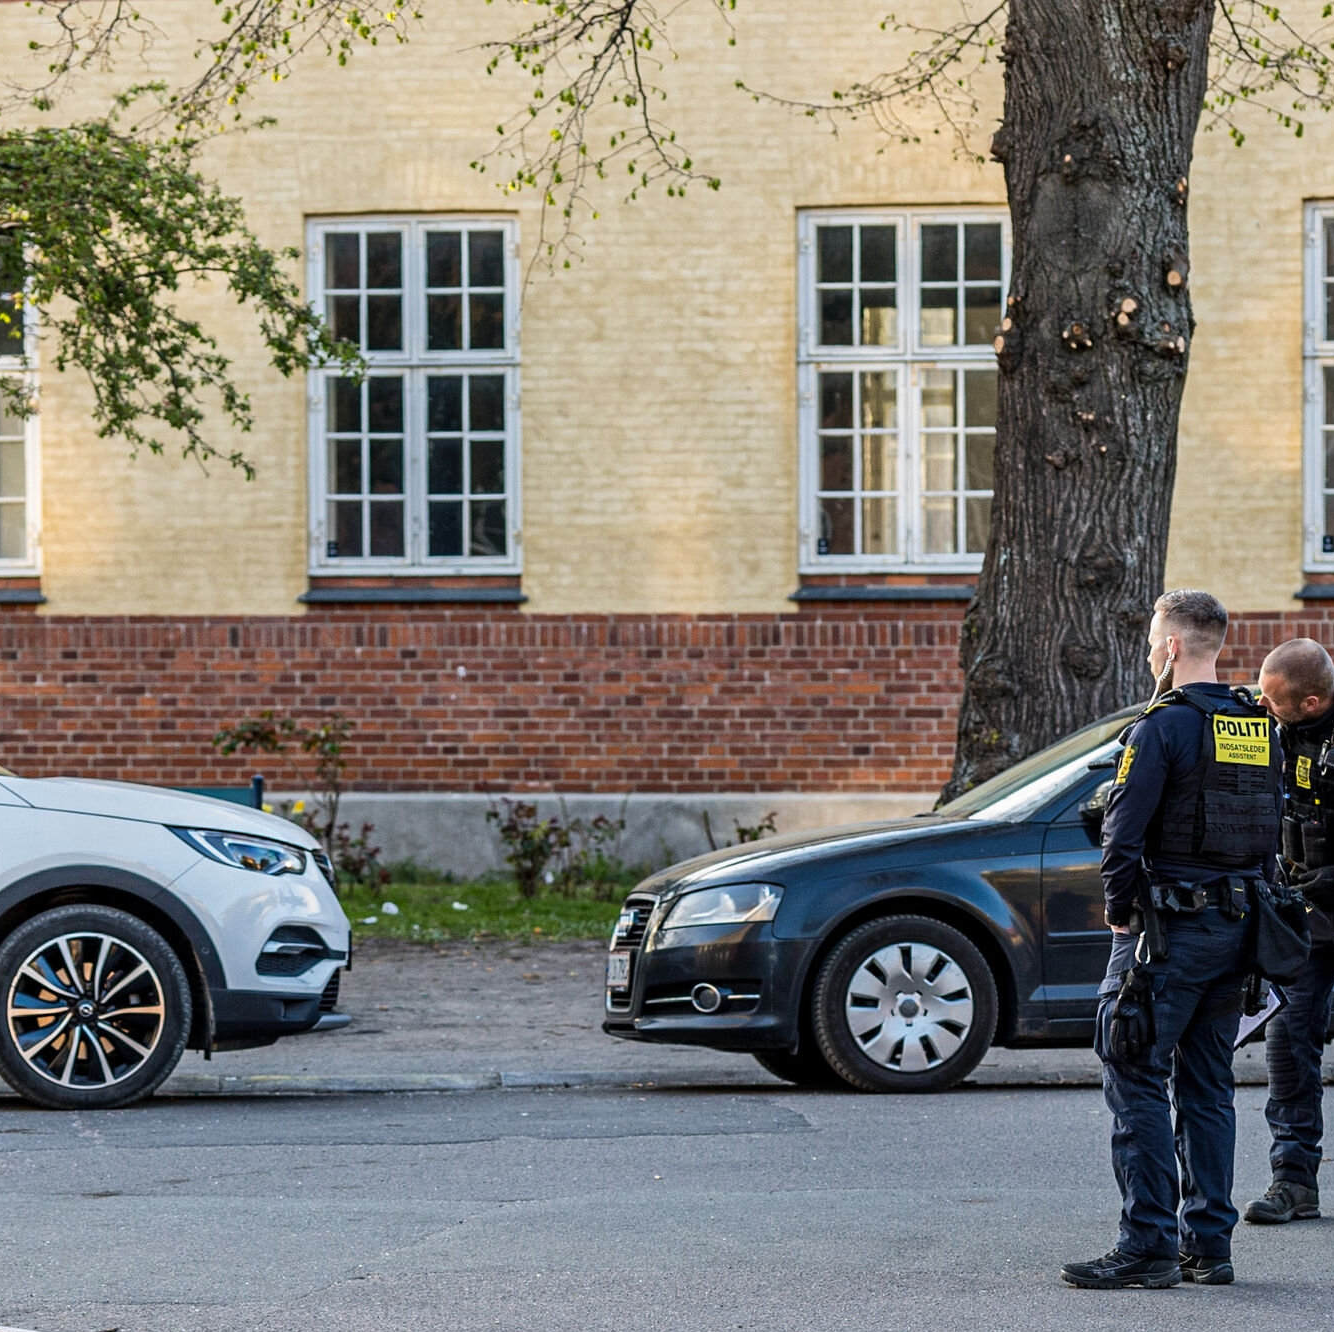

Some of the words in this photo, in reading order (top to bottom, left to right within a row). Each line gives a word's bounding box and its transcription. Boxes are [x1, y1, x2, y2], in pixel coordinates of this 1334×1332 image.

[1216, 719, 1267, 738] POLITI
[1218, 742, 1266, 753] INDSATSLEDER
[1228, 752, 1257, 761] ASSISTENT
